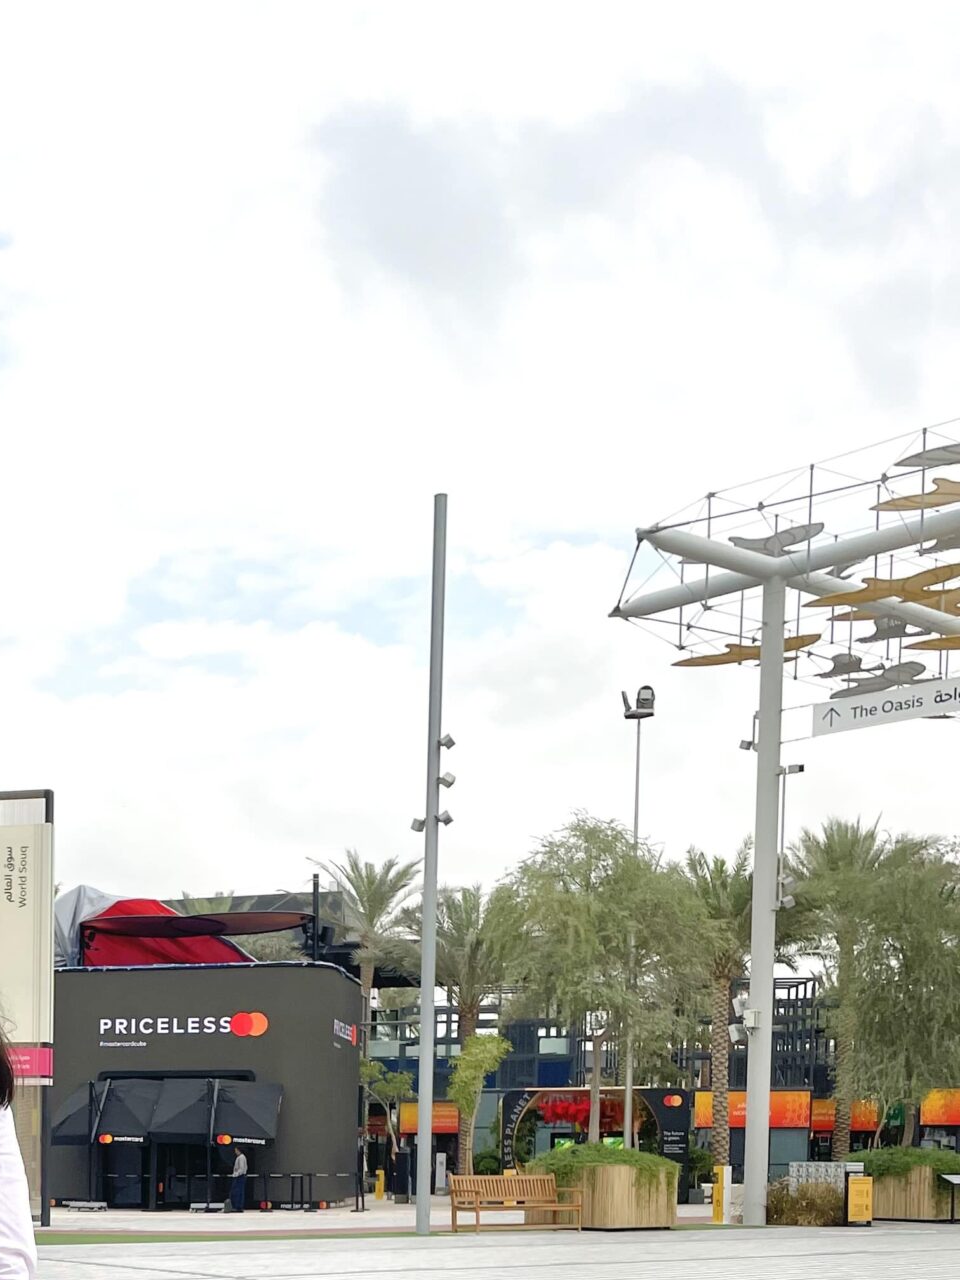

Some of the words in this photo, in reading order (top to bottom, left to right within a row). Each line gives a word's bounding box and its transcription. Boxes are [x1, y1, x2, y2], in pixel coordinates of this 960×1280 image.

[851, 705, 878, 719] The
[881, 695, 924, 713] Oasis
[3, 846, 15, 872] سوق
[18, 845, 29, 873] Souq
[3, 874, 15, 903] العالم
[18, 876, 27, 908] World
[99, 1017, 231, 1035] PRICELESS
[505, 1093, 531, 1135] PLANET
[233, 1137, 266, 1145] mastercard
